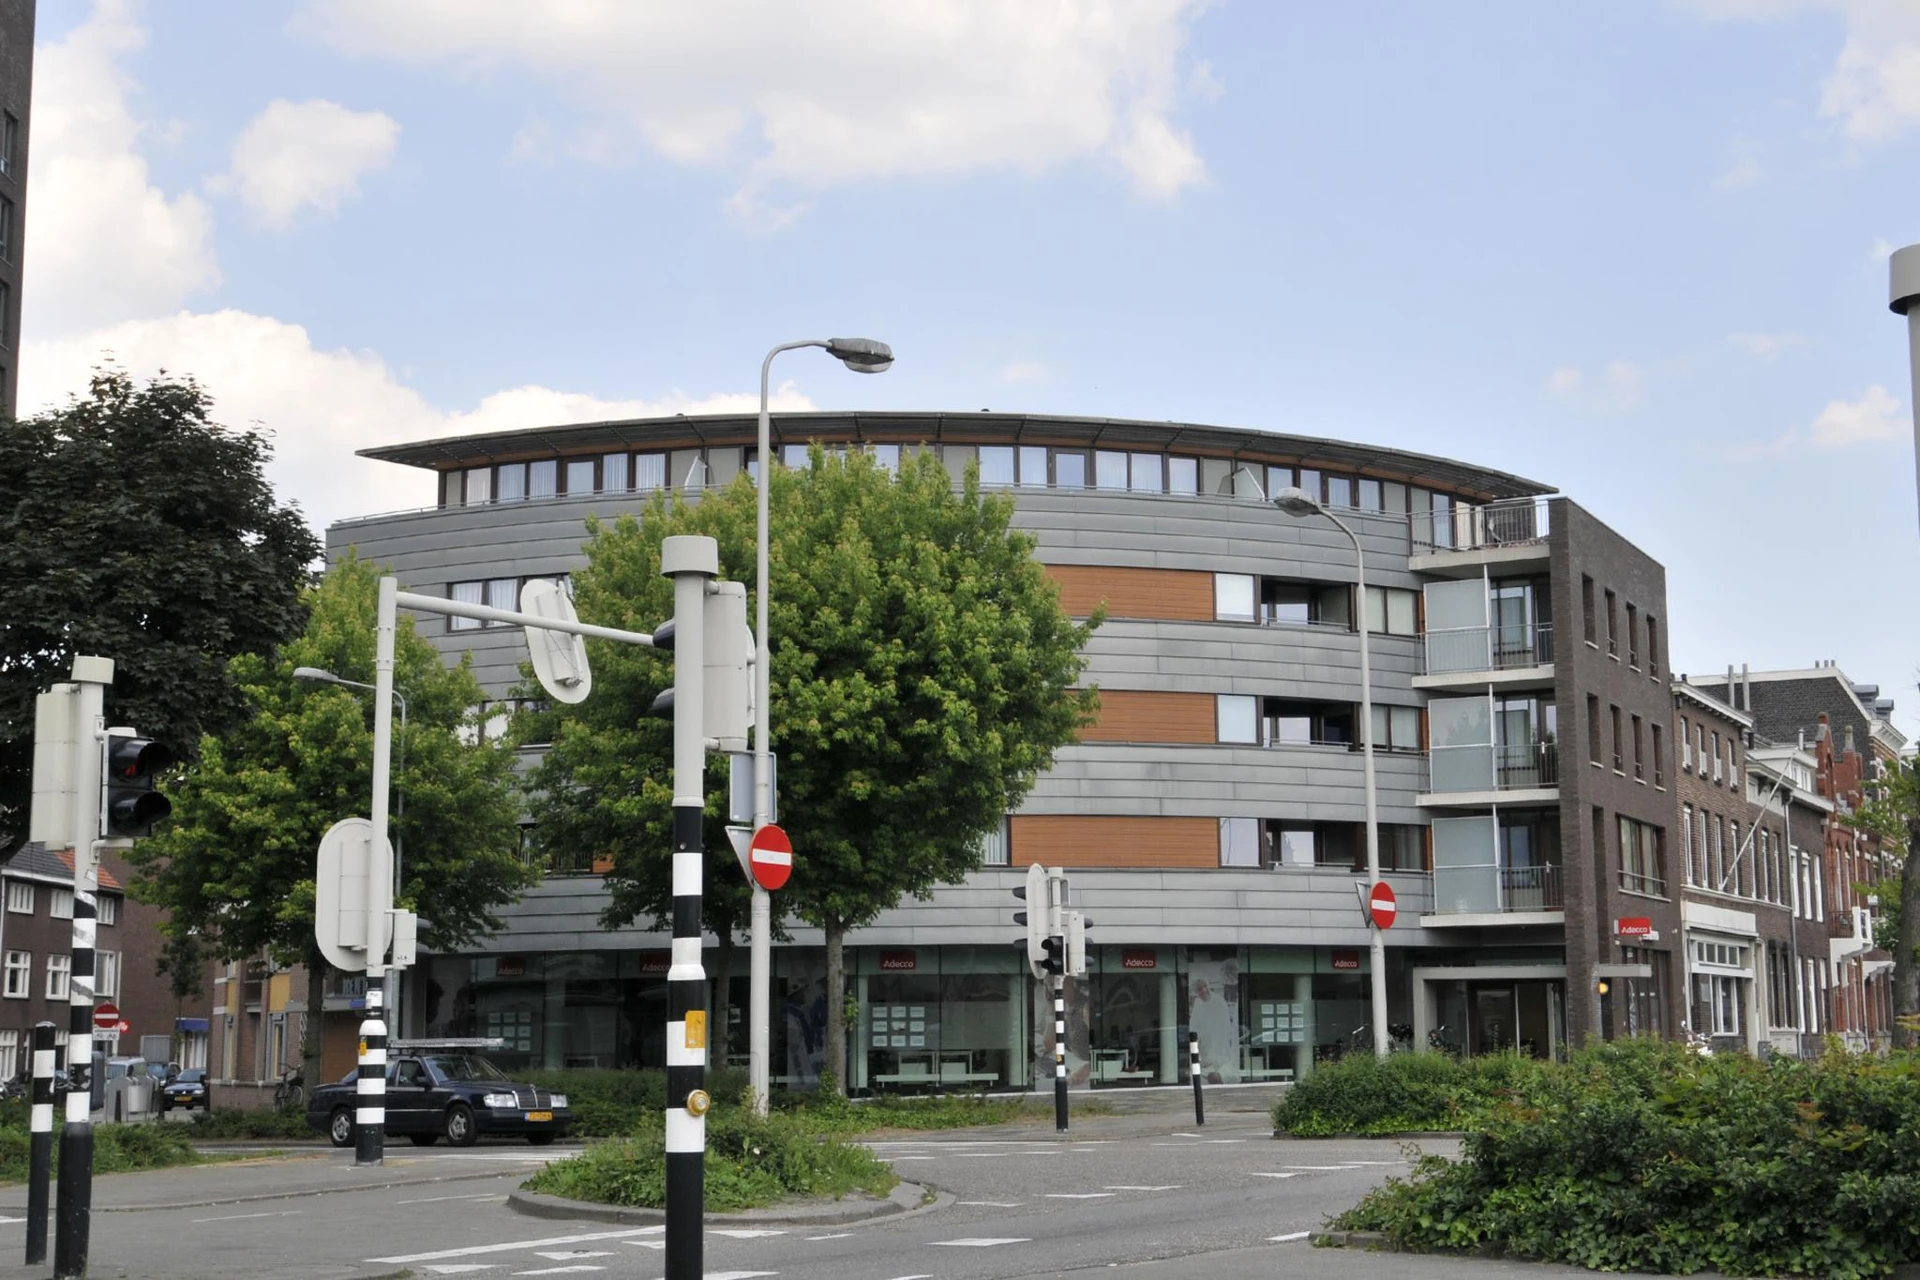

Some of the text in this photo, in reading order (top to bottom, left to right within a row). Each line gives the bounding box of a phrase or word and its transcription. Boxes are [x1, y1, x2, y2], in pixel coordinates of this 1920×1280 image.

[1621, 926, 1648, 934] Adecco
[883, 960, 914, 969] Adecco
[1125, 959, 1154, 968] Adecco
[1334, 960, 1358, 968] Adecco
